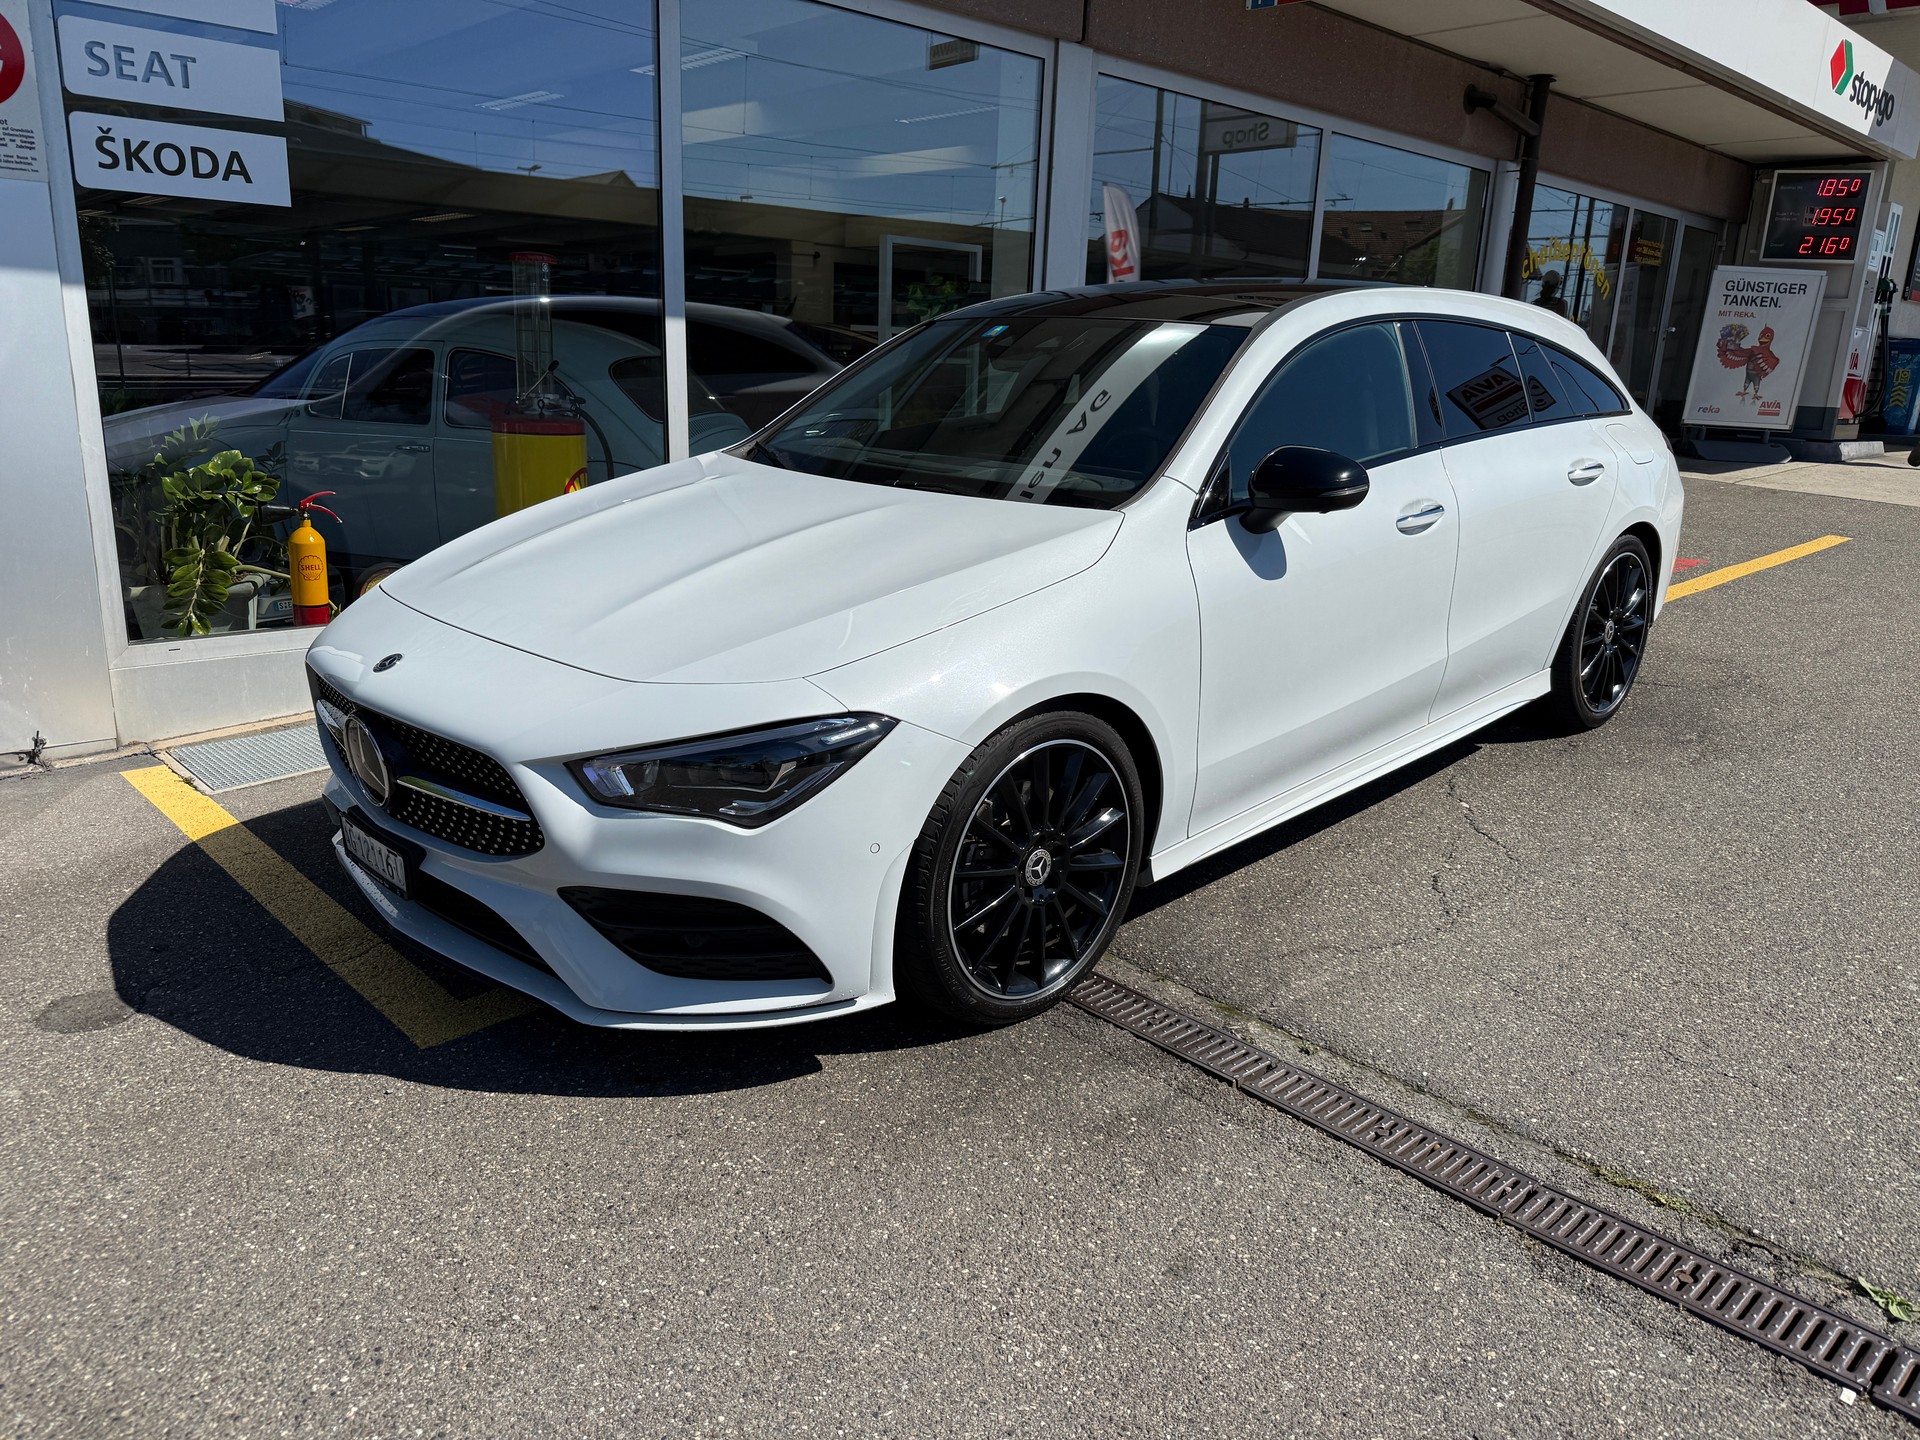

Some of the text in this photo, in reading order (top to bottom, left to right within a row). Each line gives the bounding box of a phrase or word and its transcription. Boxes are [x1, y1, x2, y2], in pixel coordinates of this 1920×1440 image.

[84, 41, 197, 89] SEAT
[95, 126, 253, 184] ŠKODA
[1816, 178, 1861, 196] 1.850
[1811, 208, 1856, 225] 1.950
[1799, 236, 1850, 254] 2.160
[1522, 236, 1610, 300] cheibentönen
[1725, 278, 1807, 295] GÜNSTIGER
[1722, 294, 1782, 308] TANKEN.
[1718, 310, 1733, 318] MIT
[1697, 400, 1781, 414] reka AVIA
